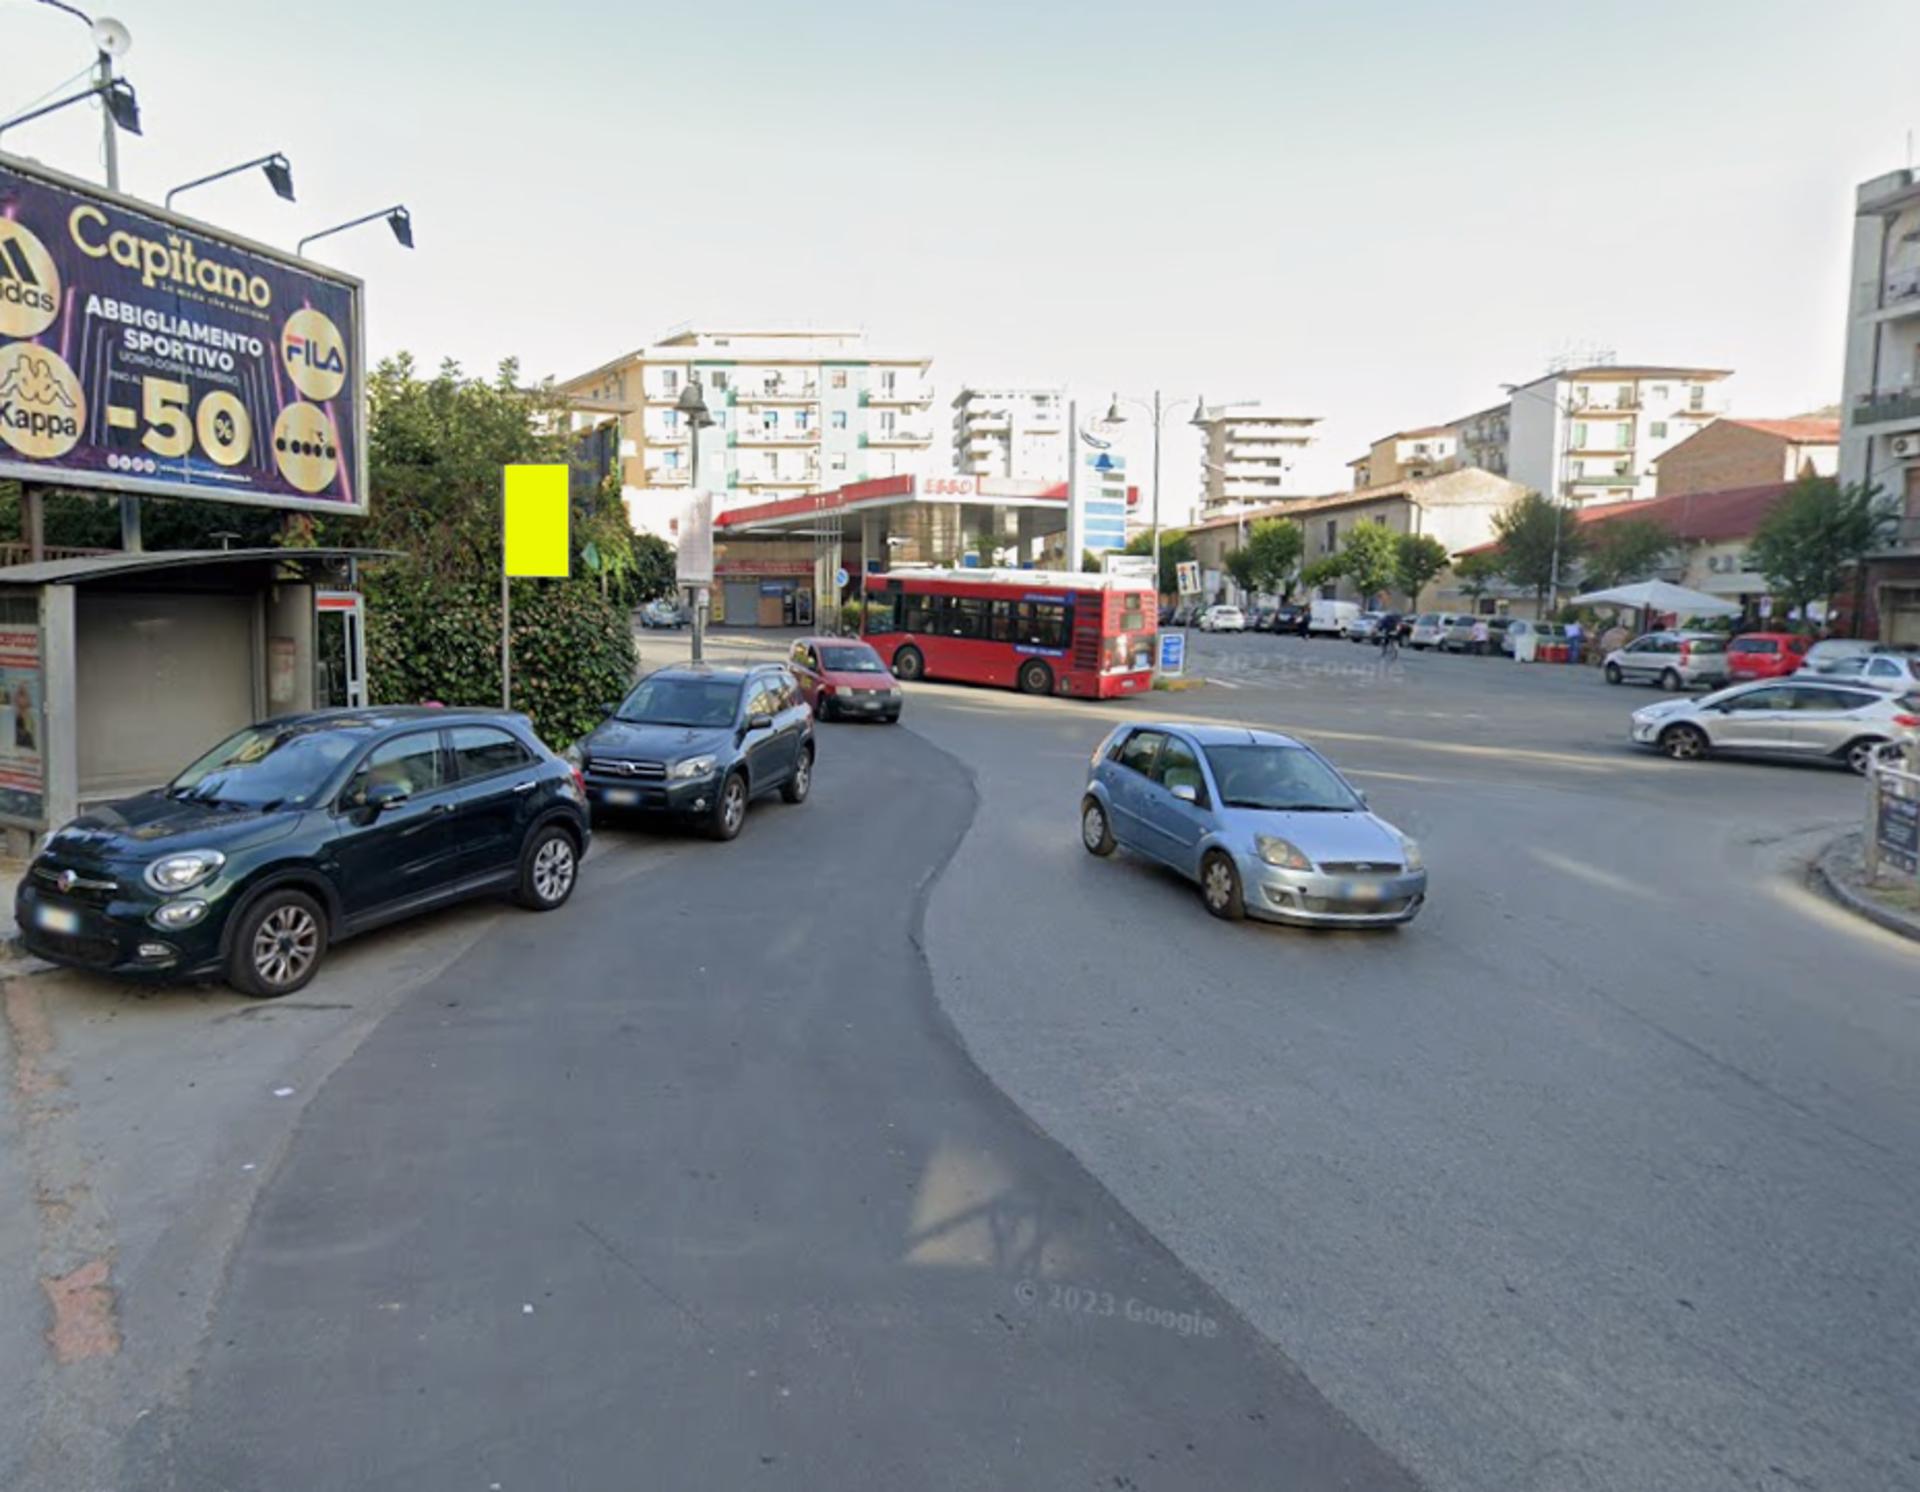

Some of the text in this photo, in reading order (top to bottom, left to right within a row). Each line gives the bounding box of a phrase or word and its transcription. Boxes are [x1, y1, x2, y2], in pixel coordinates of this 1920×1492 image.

[68, 205, 272, 308] Capitano
[85, 293, 264, 358] ABBIGLIAMENTO
[123, 327, 235, 372] SPORTIVO
[286, 333, 344, 375] FILA
